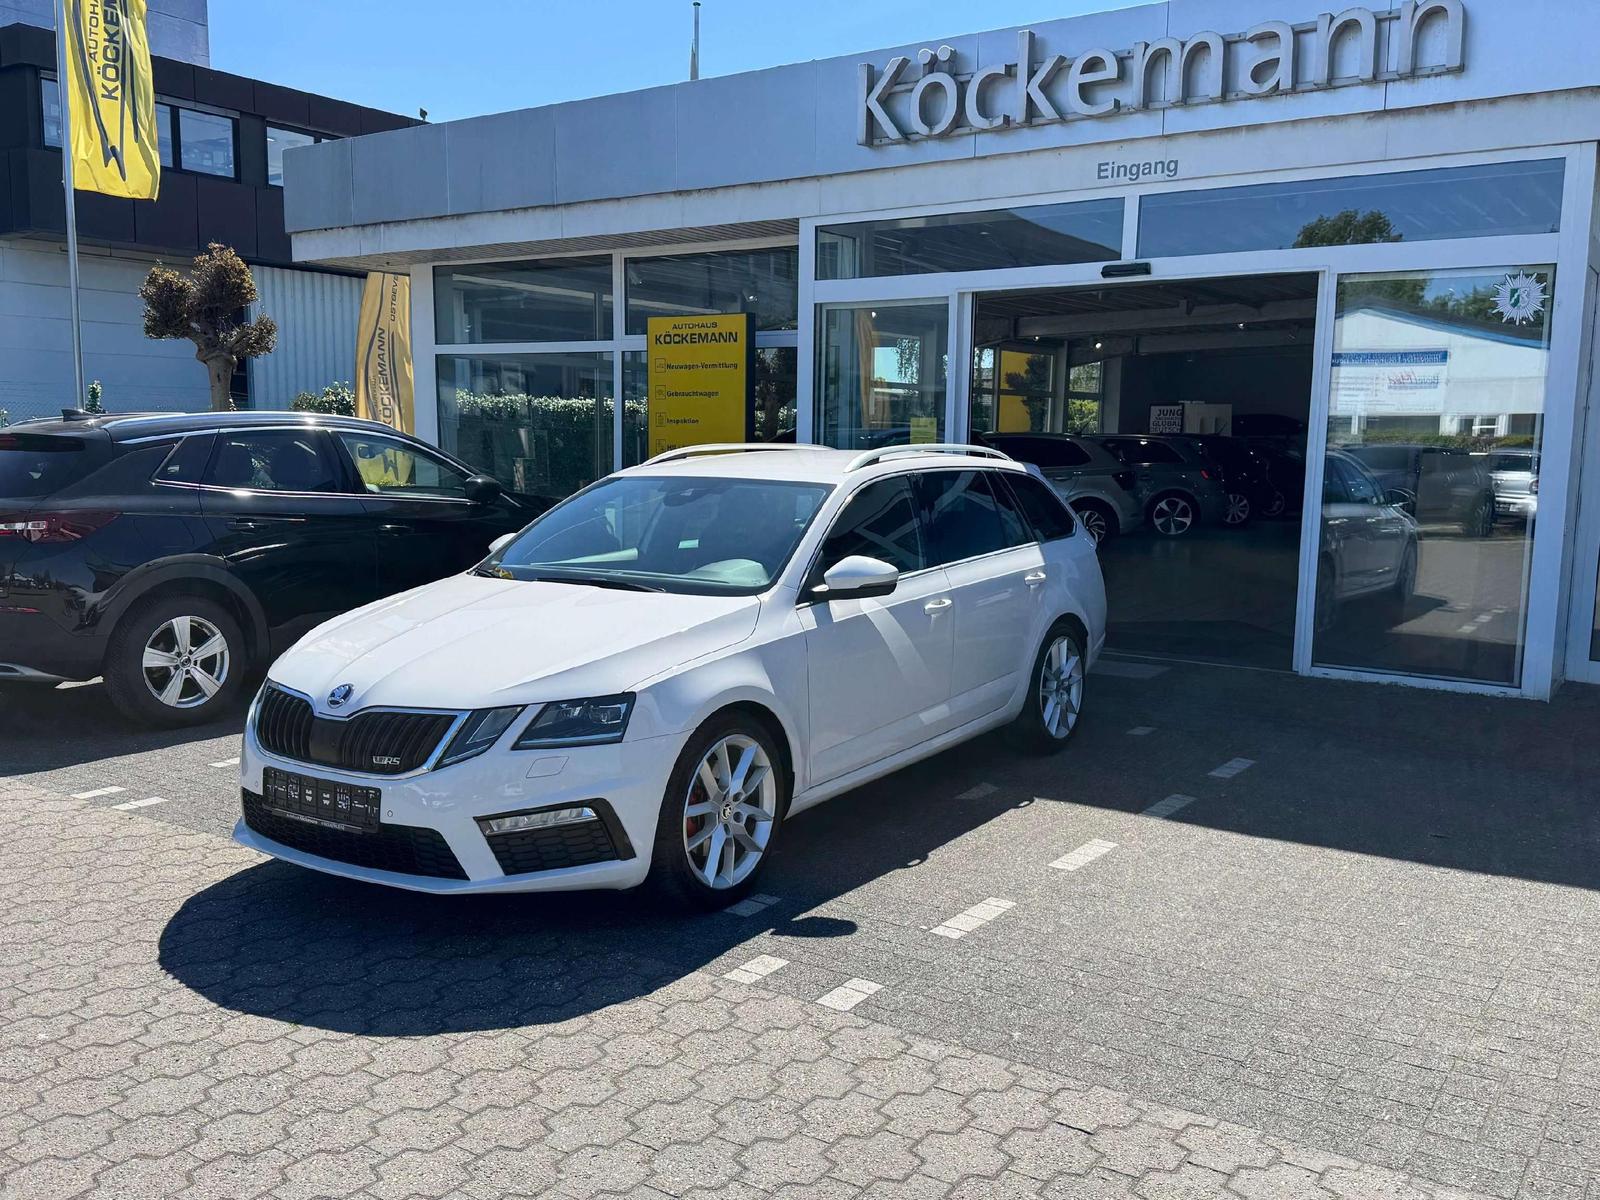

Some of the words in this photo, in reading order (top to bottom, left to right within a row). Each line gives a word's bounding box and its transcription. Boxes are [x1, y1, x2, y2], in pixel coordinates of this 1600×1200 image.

[857, 0, 1465, 146] Köckemann
[1097, 159, 1179, 181] Eingang
[672, 321, 718, 330] AUTOHAUS
[655, 331, 738, 345] KÖCKEMANN
[666, 362, 738, 371] Neuwagen-Vermittlung
[666, 390, 720, 399] Gebrauchtwagen
[666, 417, 700, 425] Inspektion
